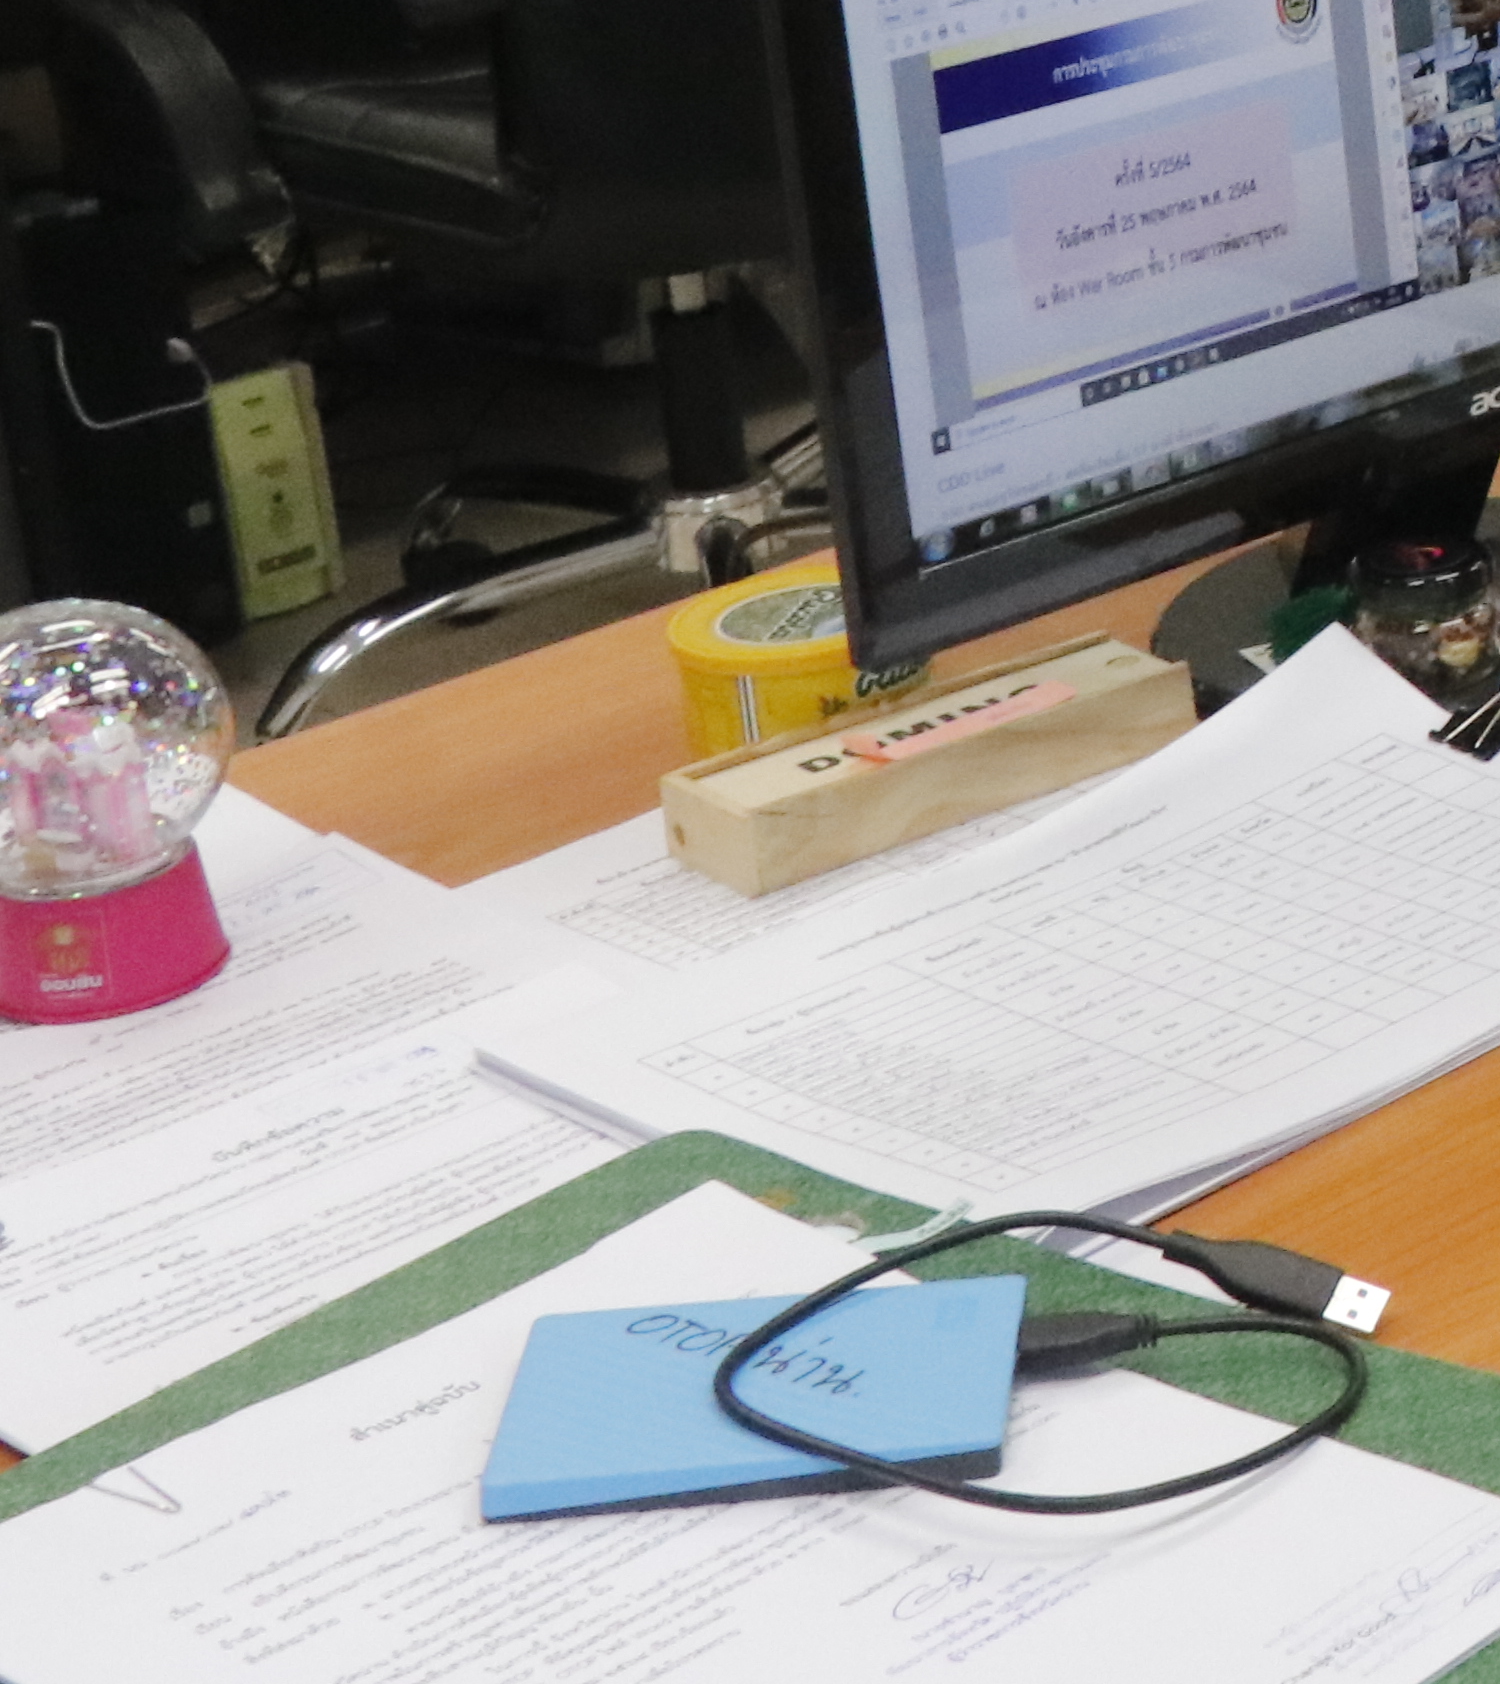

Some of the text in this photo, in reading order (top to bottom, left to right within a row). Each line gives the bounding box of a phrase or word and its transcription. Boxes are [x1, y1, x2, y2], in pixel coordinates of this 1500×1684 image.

[1149, 152, 1192, 179] 5/2564
[1121, 213, 1137, 233] 25
[1228, 178, 1258, 201] 2564
[1107, 267, 1146, 289] Room
[351, 1380, 480, 1442] สำเนาคู่ฉบับ
